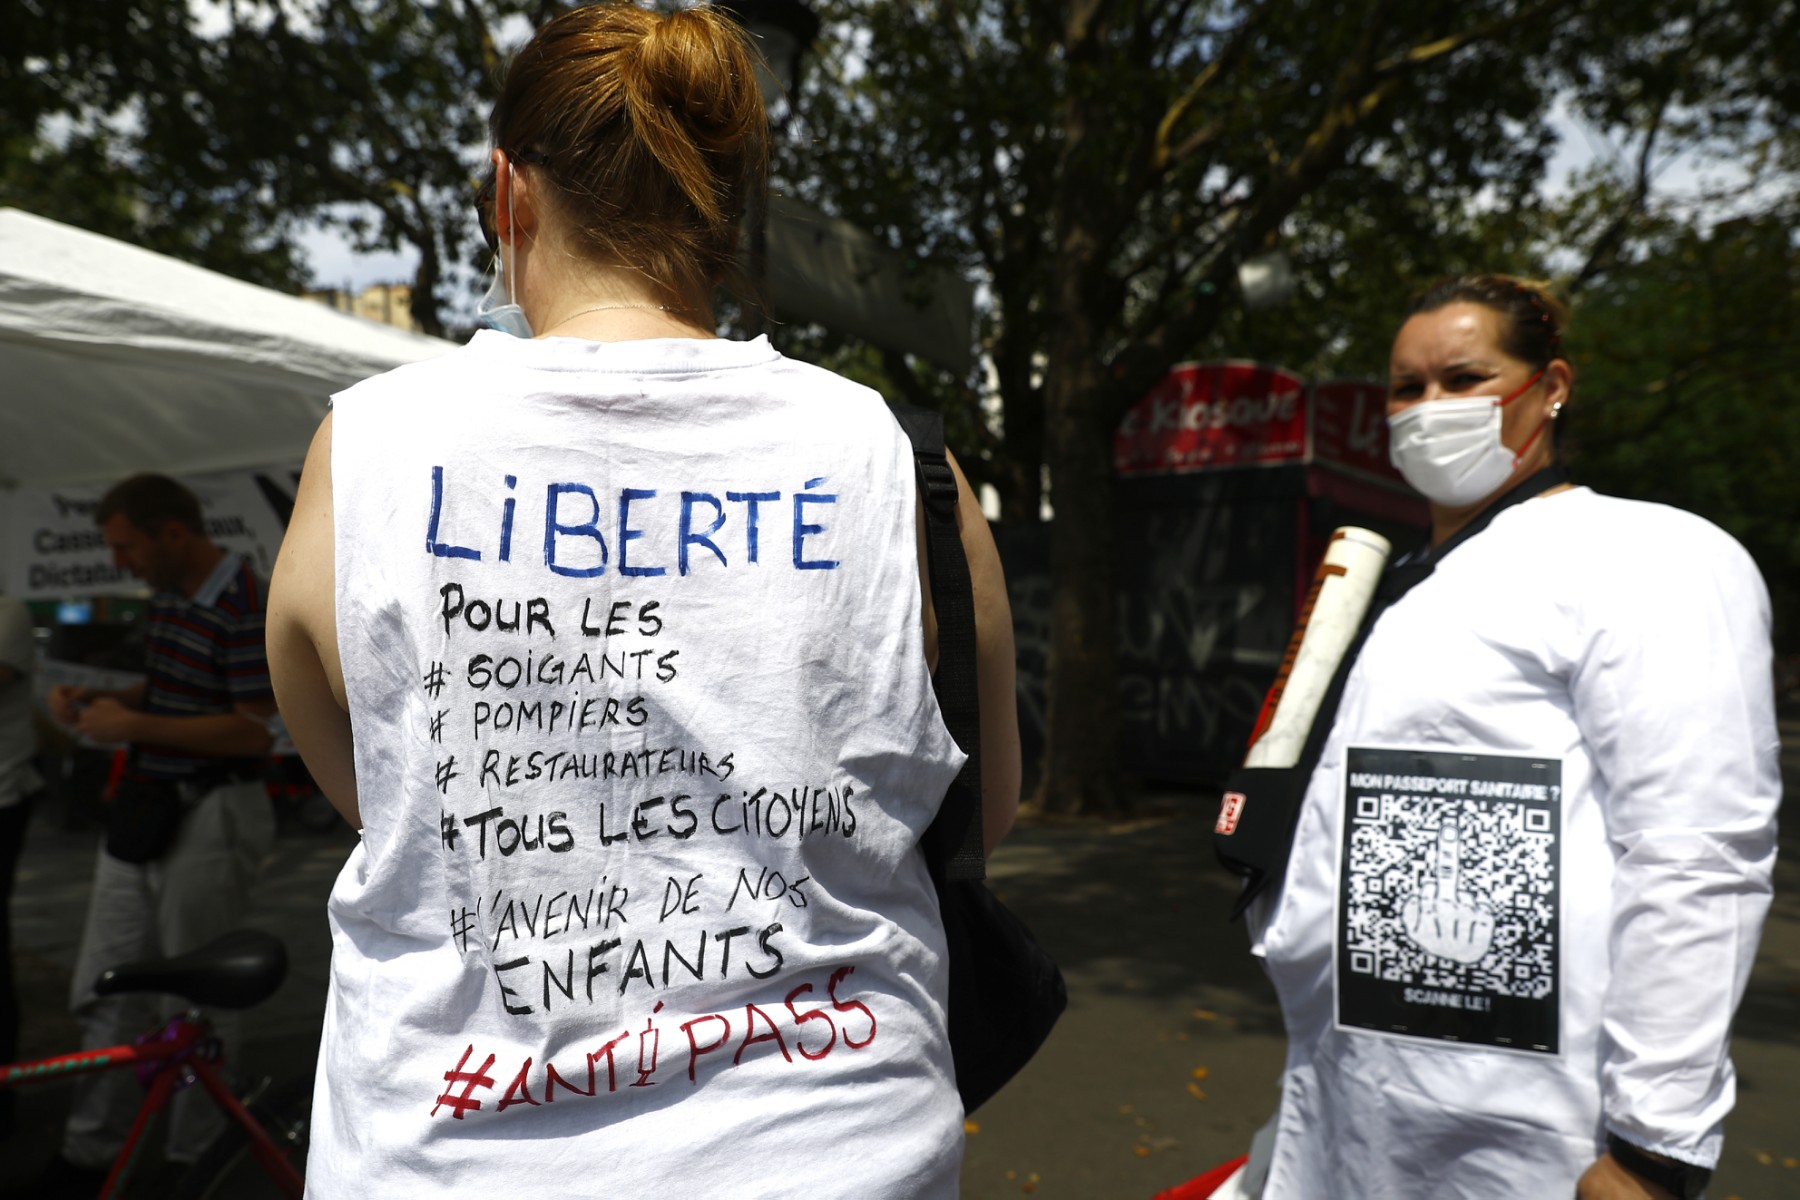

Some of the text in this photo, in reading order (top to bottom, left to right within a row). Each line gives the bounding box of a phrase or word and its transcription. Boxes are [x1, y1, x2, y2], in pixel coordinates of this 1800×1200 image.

[440, 582, 663, 640] POUR LES
[480, 747, 735, 789] RESTAURATEURS
[1350, 772, 1383, 790] MON
[1383, 774, 1469, 795] PASSEPORT
[1469, 780, 1549, 801] SANITAIRE
[600, 795, 699, 846] LES
[660, 874, 704, 923] DE
[725, 866, 811, 914] NOS
[494, 923, 784, 1016] ENFANTS
